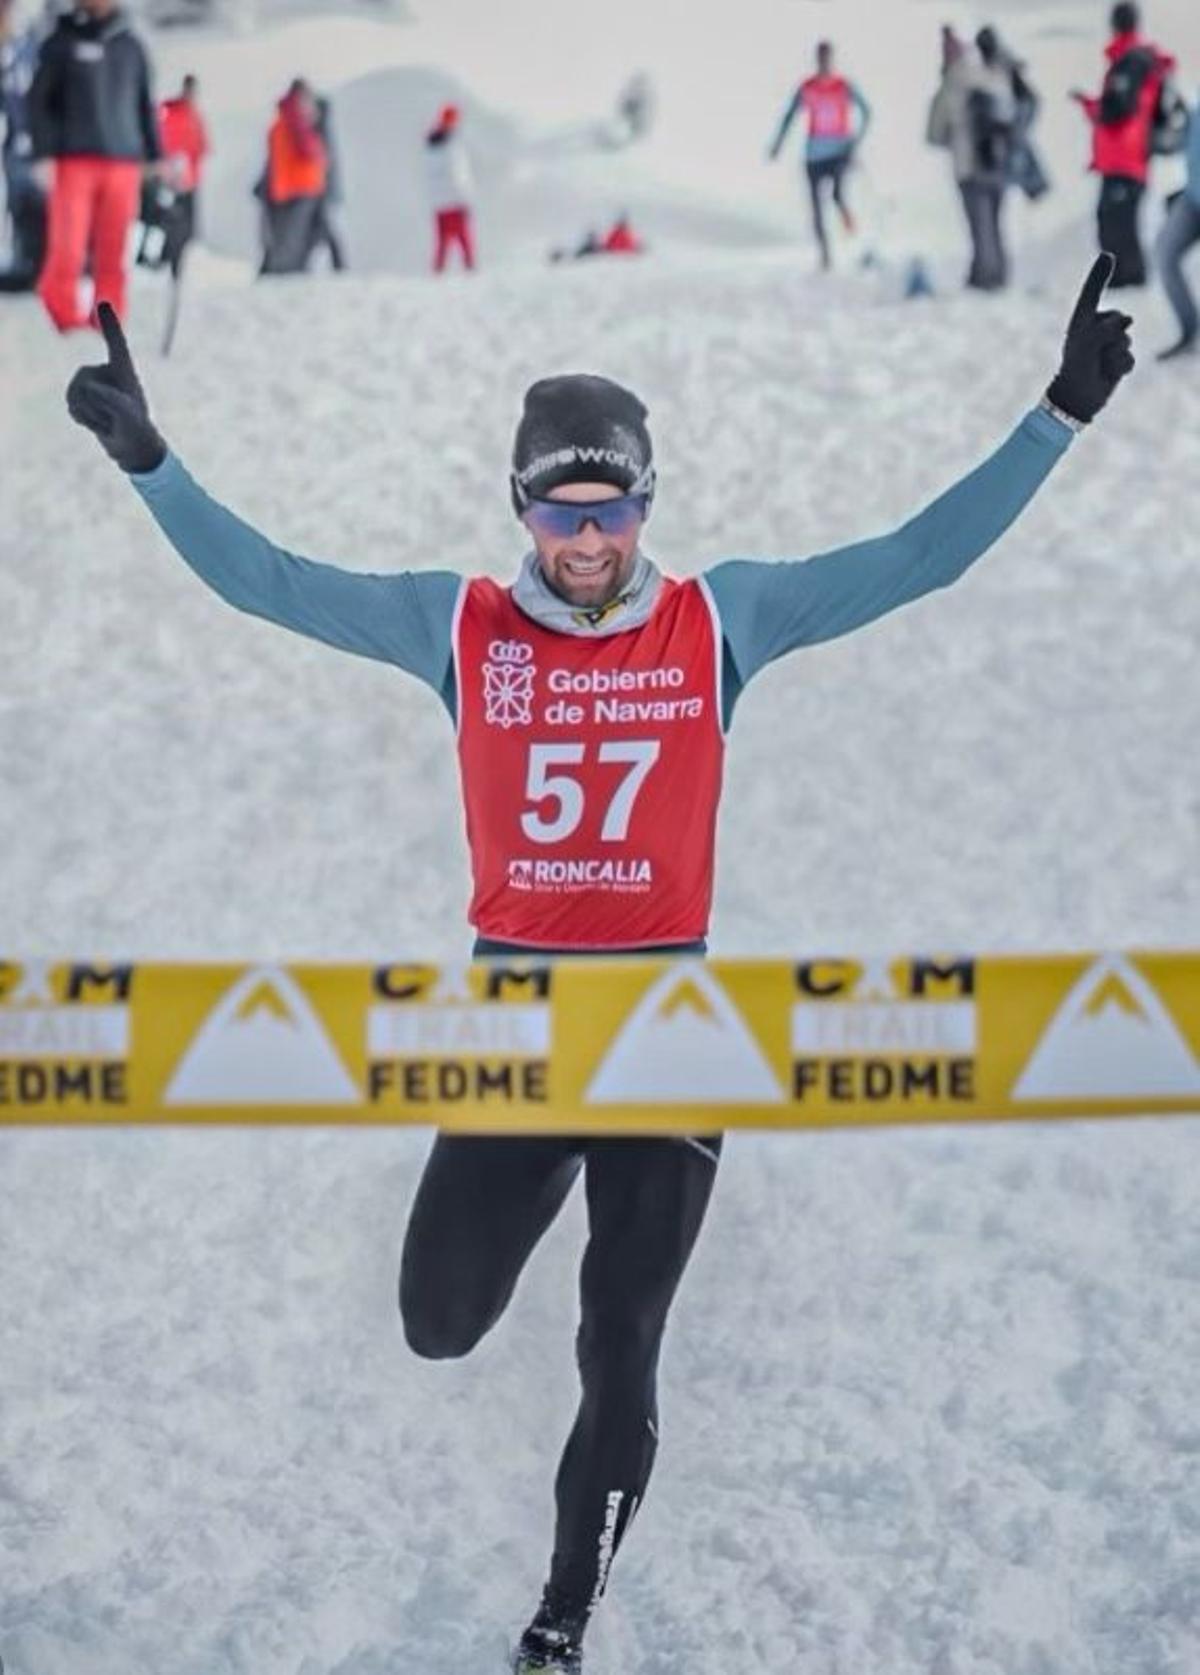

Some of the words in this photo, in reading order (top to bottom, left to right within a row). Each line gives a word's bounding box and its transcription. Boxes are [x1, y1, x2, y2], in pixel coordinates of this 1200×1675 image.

[548, 667, 685, 694] Gobierno
[544, 701, 585, 725] de
[594, 697, 704, 724] Navarra
[519, 740, 662, 844] 57
[534, 859, 653, 884] RONCALIA
[367, 1060, 550, 1104] FEDME
[792, 1056, 976, 1101] FEDME
